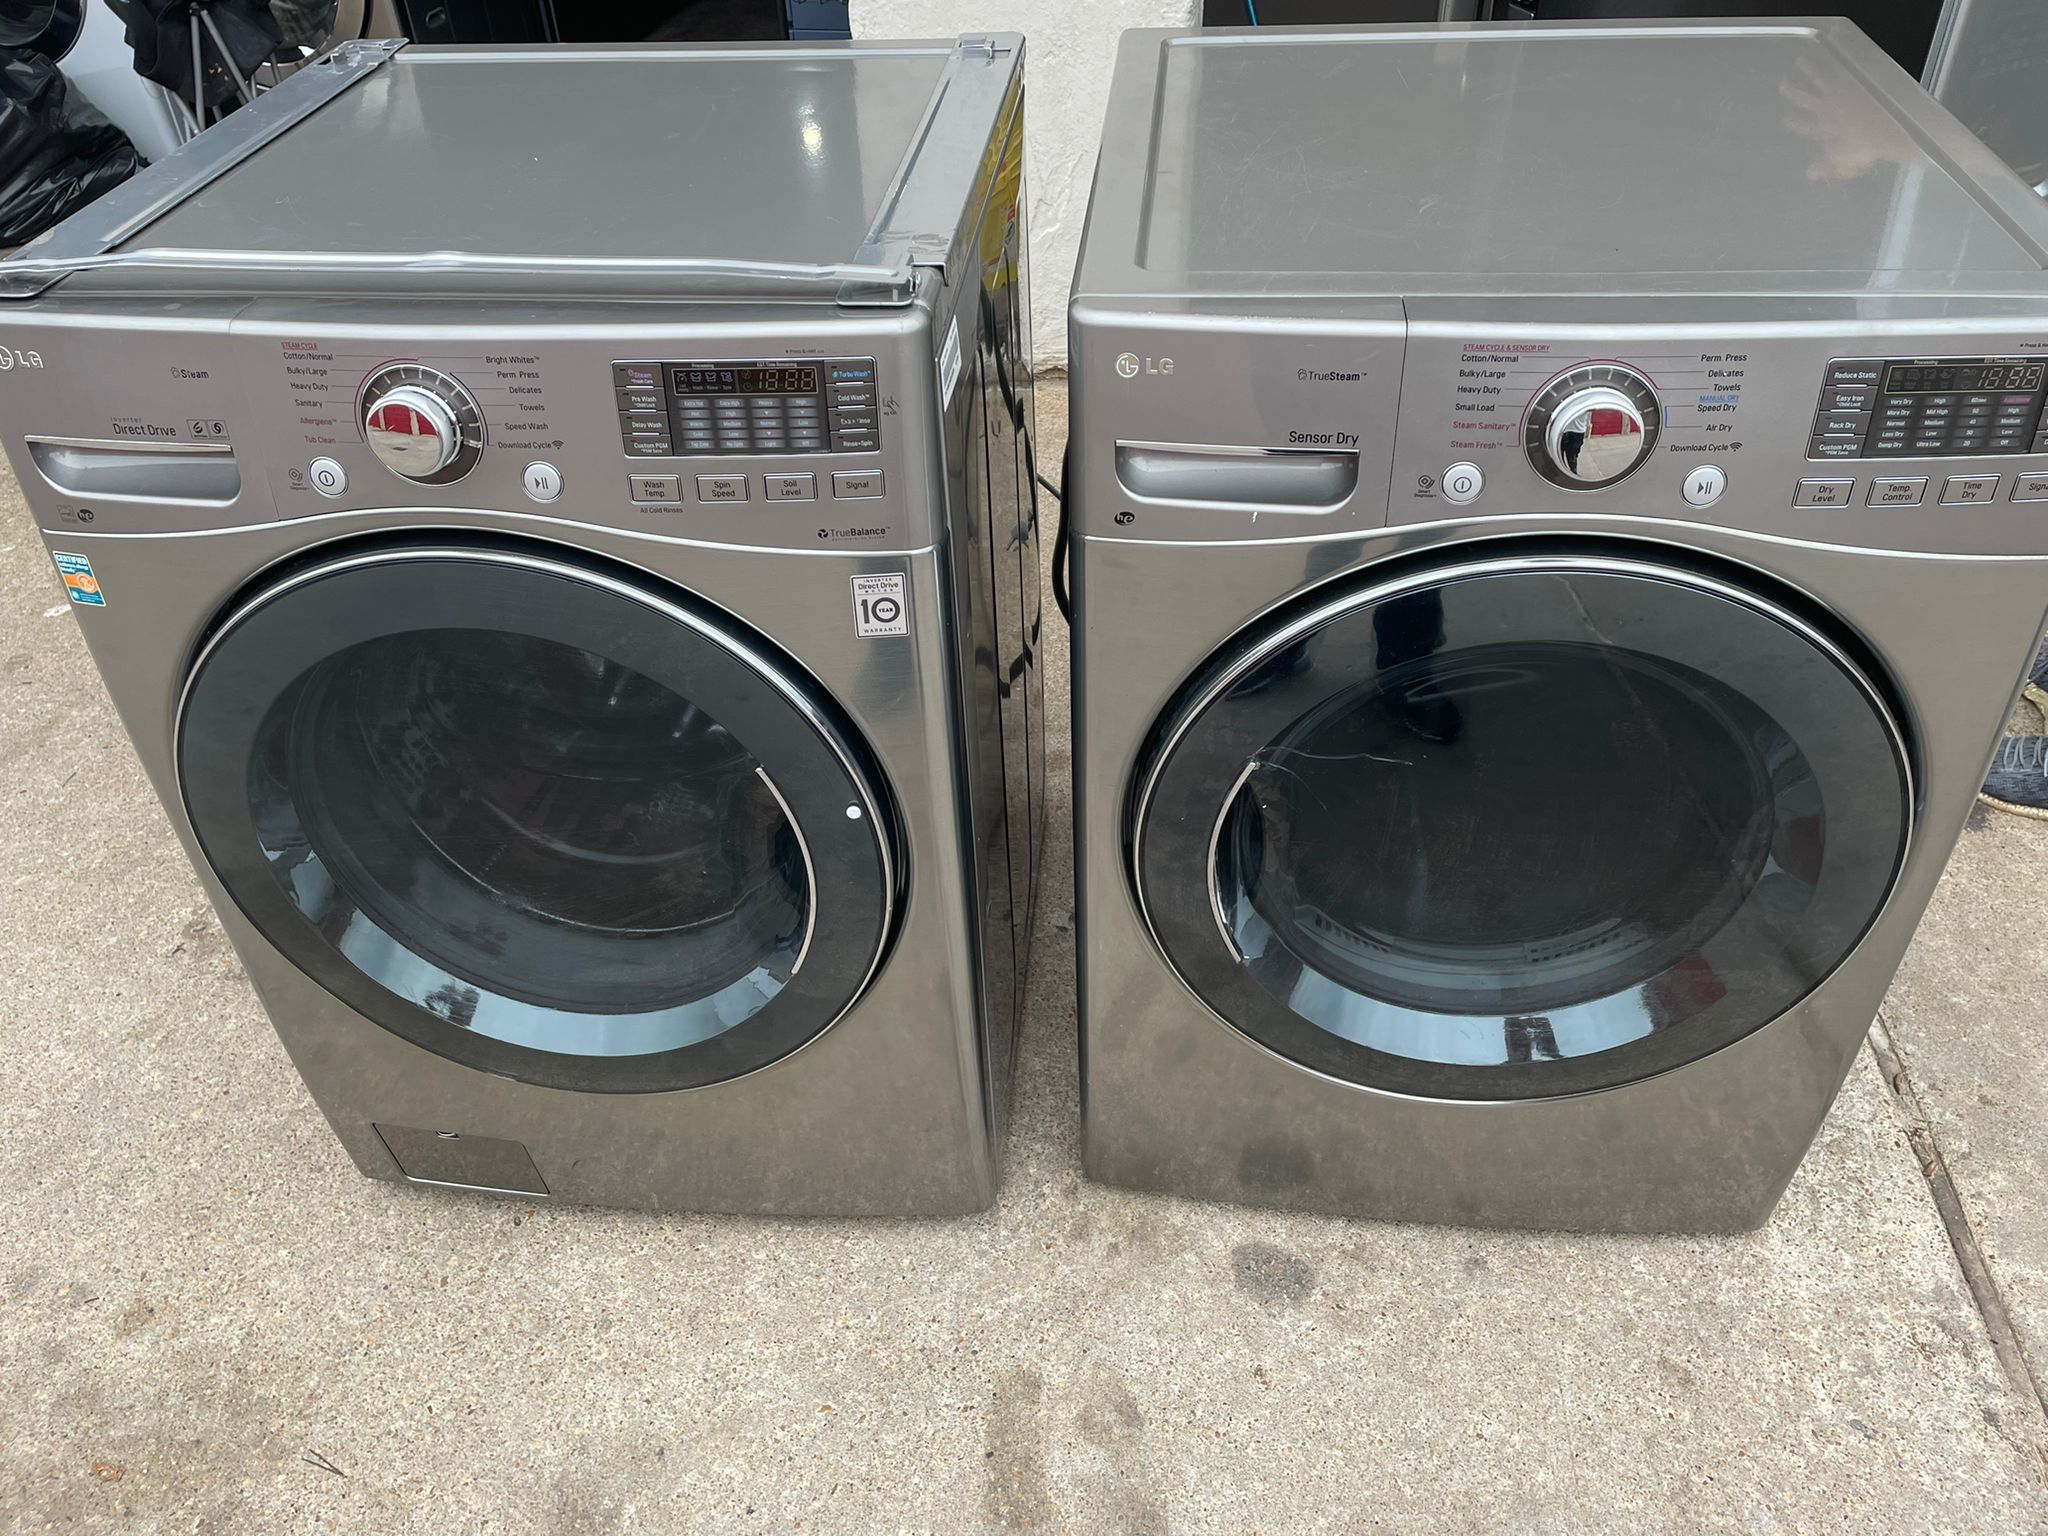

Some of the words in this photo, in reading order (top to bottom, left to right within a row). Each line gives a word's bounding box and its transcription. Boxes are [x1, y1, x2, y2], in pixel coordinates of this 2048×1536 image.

[281, 342, 301, 350] STEAM
[15, 350, 44, 369] LG
[283, 351, 334, 361] Cotton/Normal
[486, 356, 508, 365] Bright
[1461, 354, 1519, 362] Cotton/Normal
[1725, 353, 1748, 362] Press
[1145, 357, 1174, 375] LG
[180, 369, 209, 379] Steam
[286, 366, 328, 377] Bulky/Large
[519, 371, 540, 379] Press
[634, 371, 653, 379] Steam
[1459, 369, 1506, 379] Bulky/Large
[1708, 370, 1744, 378] Delicates
[290, 382, 311, 391] Heavy
[312, 382, 329, 392] Duty
[1457, 385, 1482, 395] Heavy
[1482, 386, 1502, 395] Duty
[1713, 383, 1742, 392] Towels
[1699, 394, 1726, 403] MANUAL
[1727, 394, 1740, 403] DRY
[294, 399, 323, 408] Sanitary
[519, 403, 546, 411] Towels
[1455, 403, 1476, 411] Small
[1476, 403, 1495, 411] Load
[1697, 404, 1721, 413] Speed
[1723, 404, 1738, 413] Dry
[113, 423, 147, 436] Direct
[147, 424, 177, 436] Drive
[505, 423, 527, 431] Speed
[529, 422, 549, 430] Wash
[632, 421, 647, 429] Delay
[1453, 421, 1477, 429] Steam
[1706, 424, 1718, 432] Air
[1719, 424, 1733, 432] Dry
[304, 435, 318, 443] Tub
[318, 436, 337, 444] Clean
[1289, 430, 1334, 444] Sensor
[1336, 432, 1359, 447] Dry
[498, 441, 531, 449] Download
[533, 441, 552, 450] Cycle
[1450, 441, 1475, 449] Steam
[1670, 444, 1707, 452] Download
[1708, 443, 1729, 452] Cycle
[714, 481, 730, 489] Spin
[783, 480, 797, 488] Soil
[845, 481, 869, 490] Signal
[1963, 482, 1982, 490] Time
[712, 490, 736, 498] Speed
[780, 488, 801, 496] Level
[1819, 486, 1834, 494] Dry
[1812, 495, 1835, 503] Level
[1882, 493, 1913, 501] Control
[1962, 491, 1977, 499] Dry
[861, 597, 900, 624] 10
